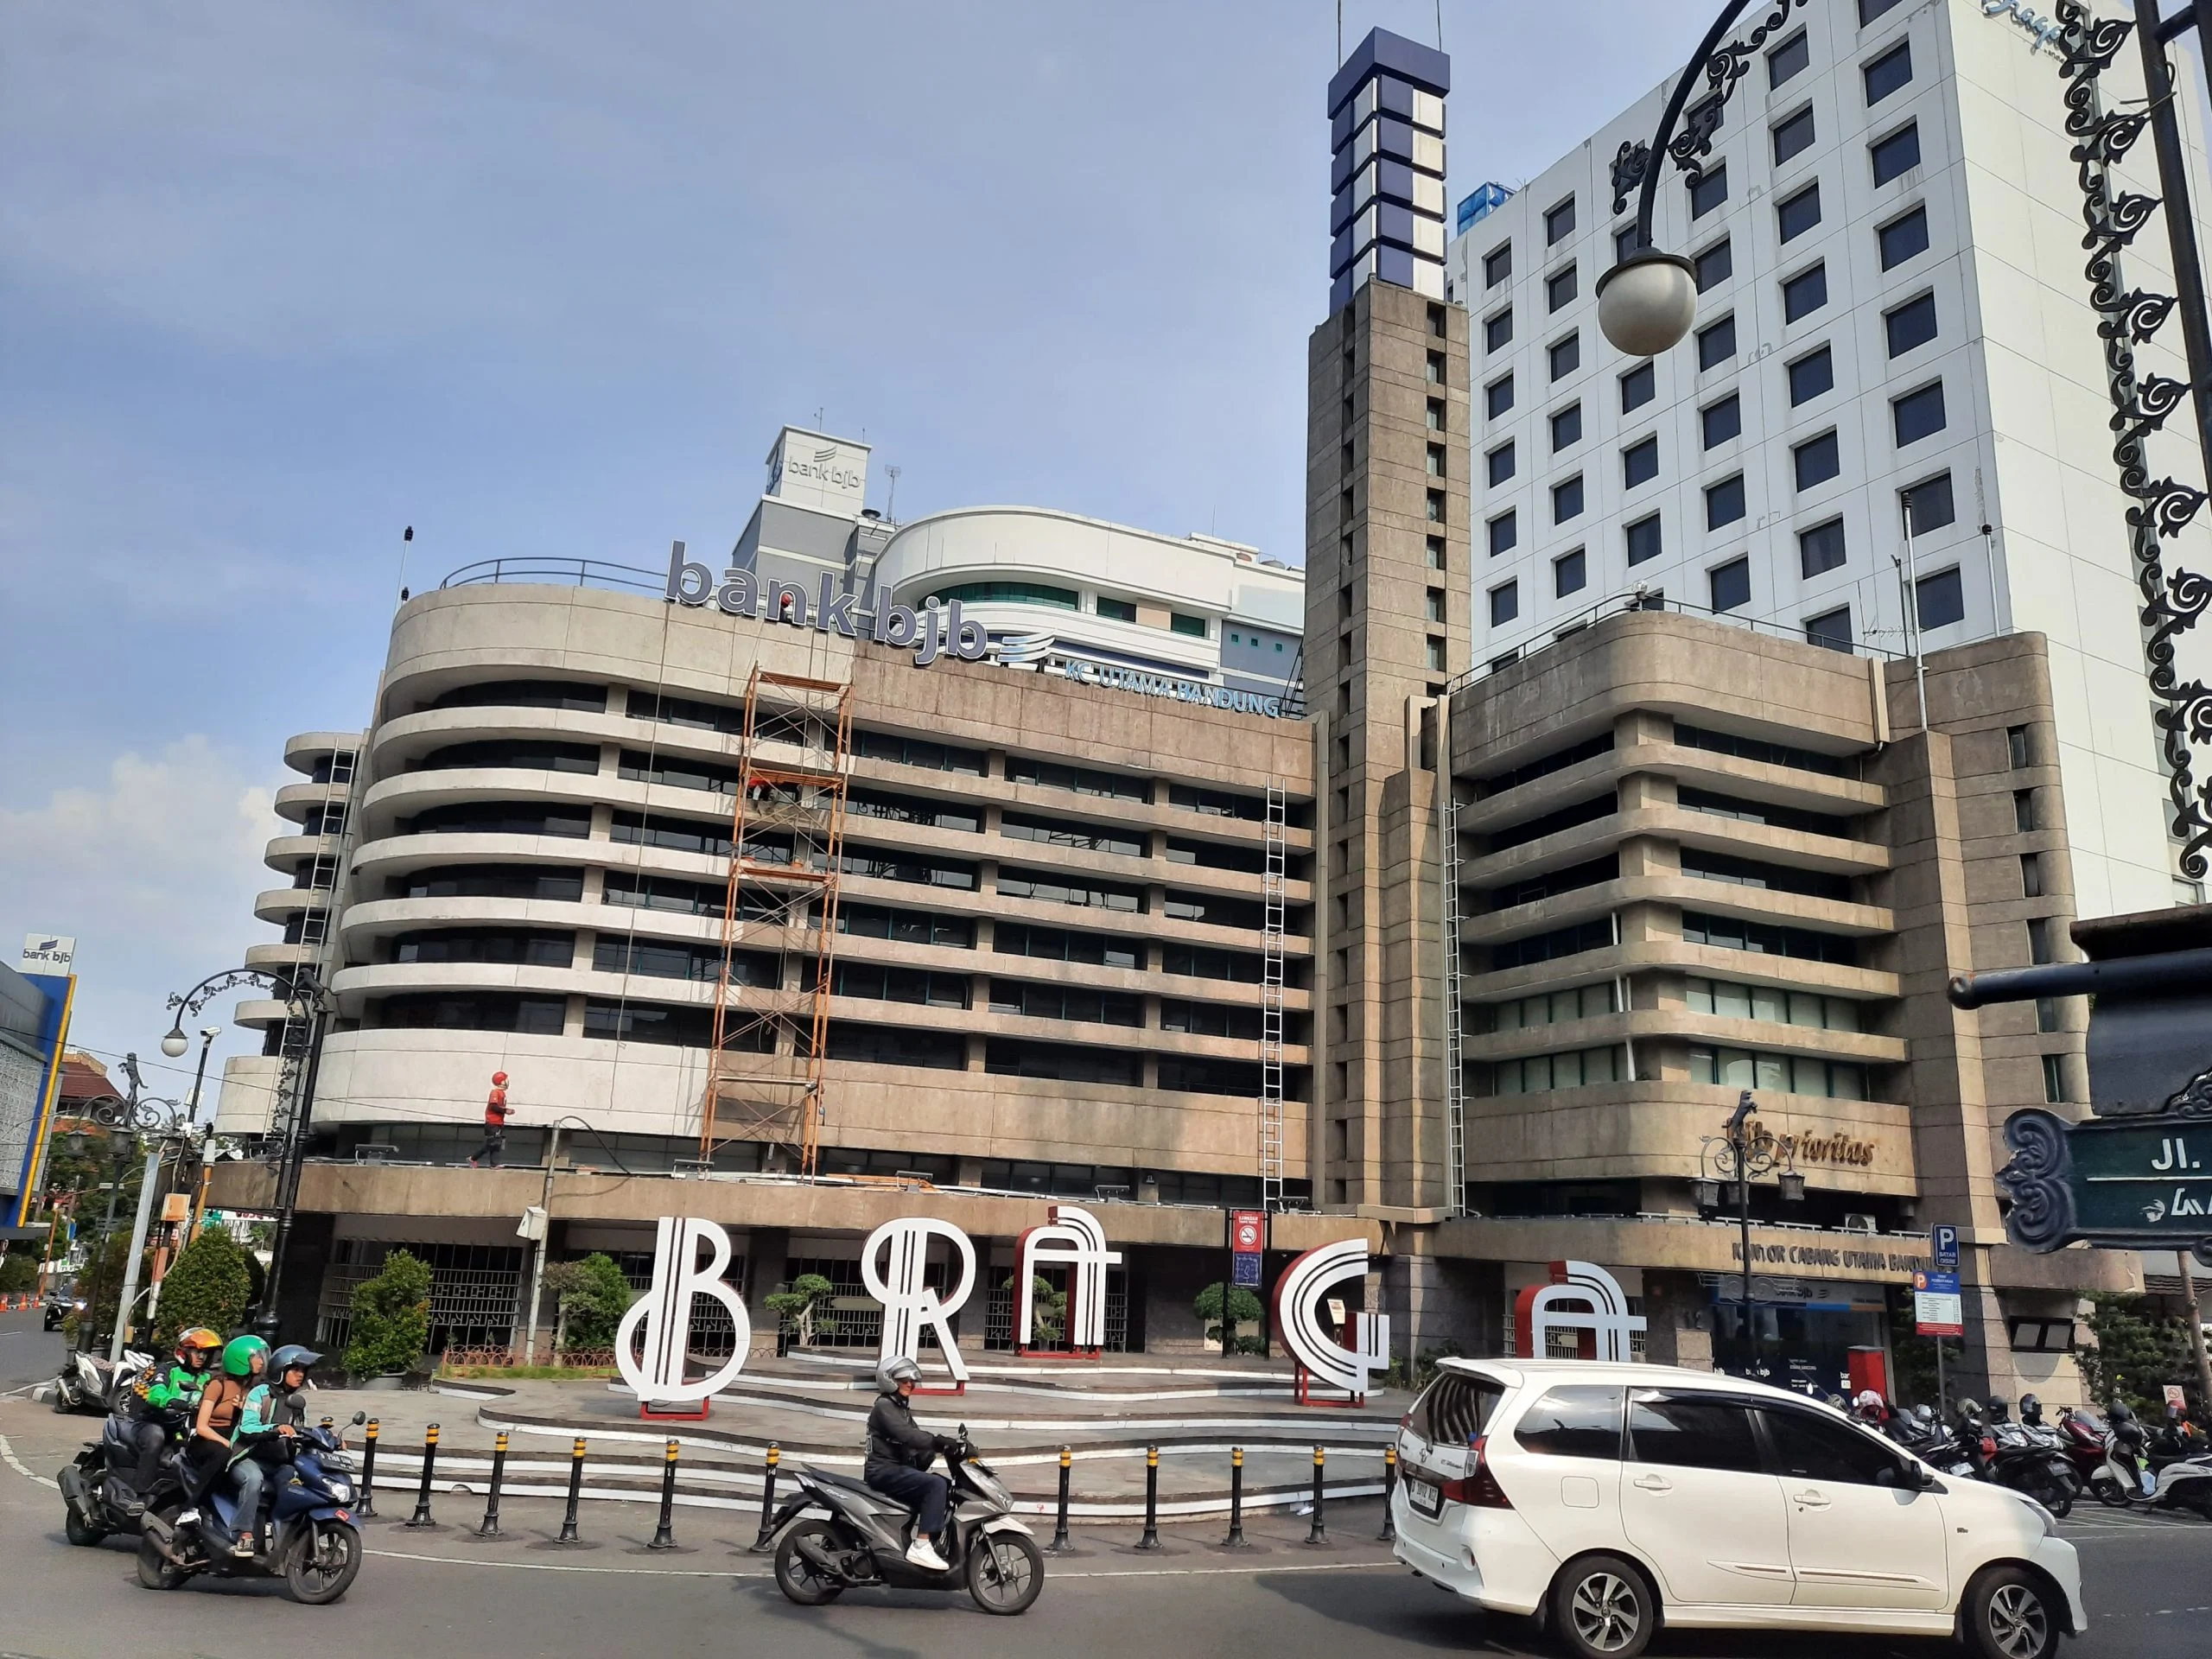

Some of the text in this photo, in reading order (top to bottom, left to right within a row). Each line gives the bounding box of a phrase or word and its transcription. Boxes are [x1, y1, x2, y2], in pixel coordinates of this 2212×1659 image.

[788, 456, 829, 481] bank
[831, 467, 861, 489] bjb
[664, 539, 988, 666] bank bjb
[1064, 658, 1282, 718] KC UTAMA BANDUNG
[22, 949, 71, 964] bank bjb
[2151, 1137, 2201, 1171] Jl.
[1940, 1228, 1955, 1250] P
[1789, 1245, 1841, 1267] CABANG
[1842, 1250, 1886, 1271] UTAMA
